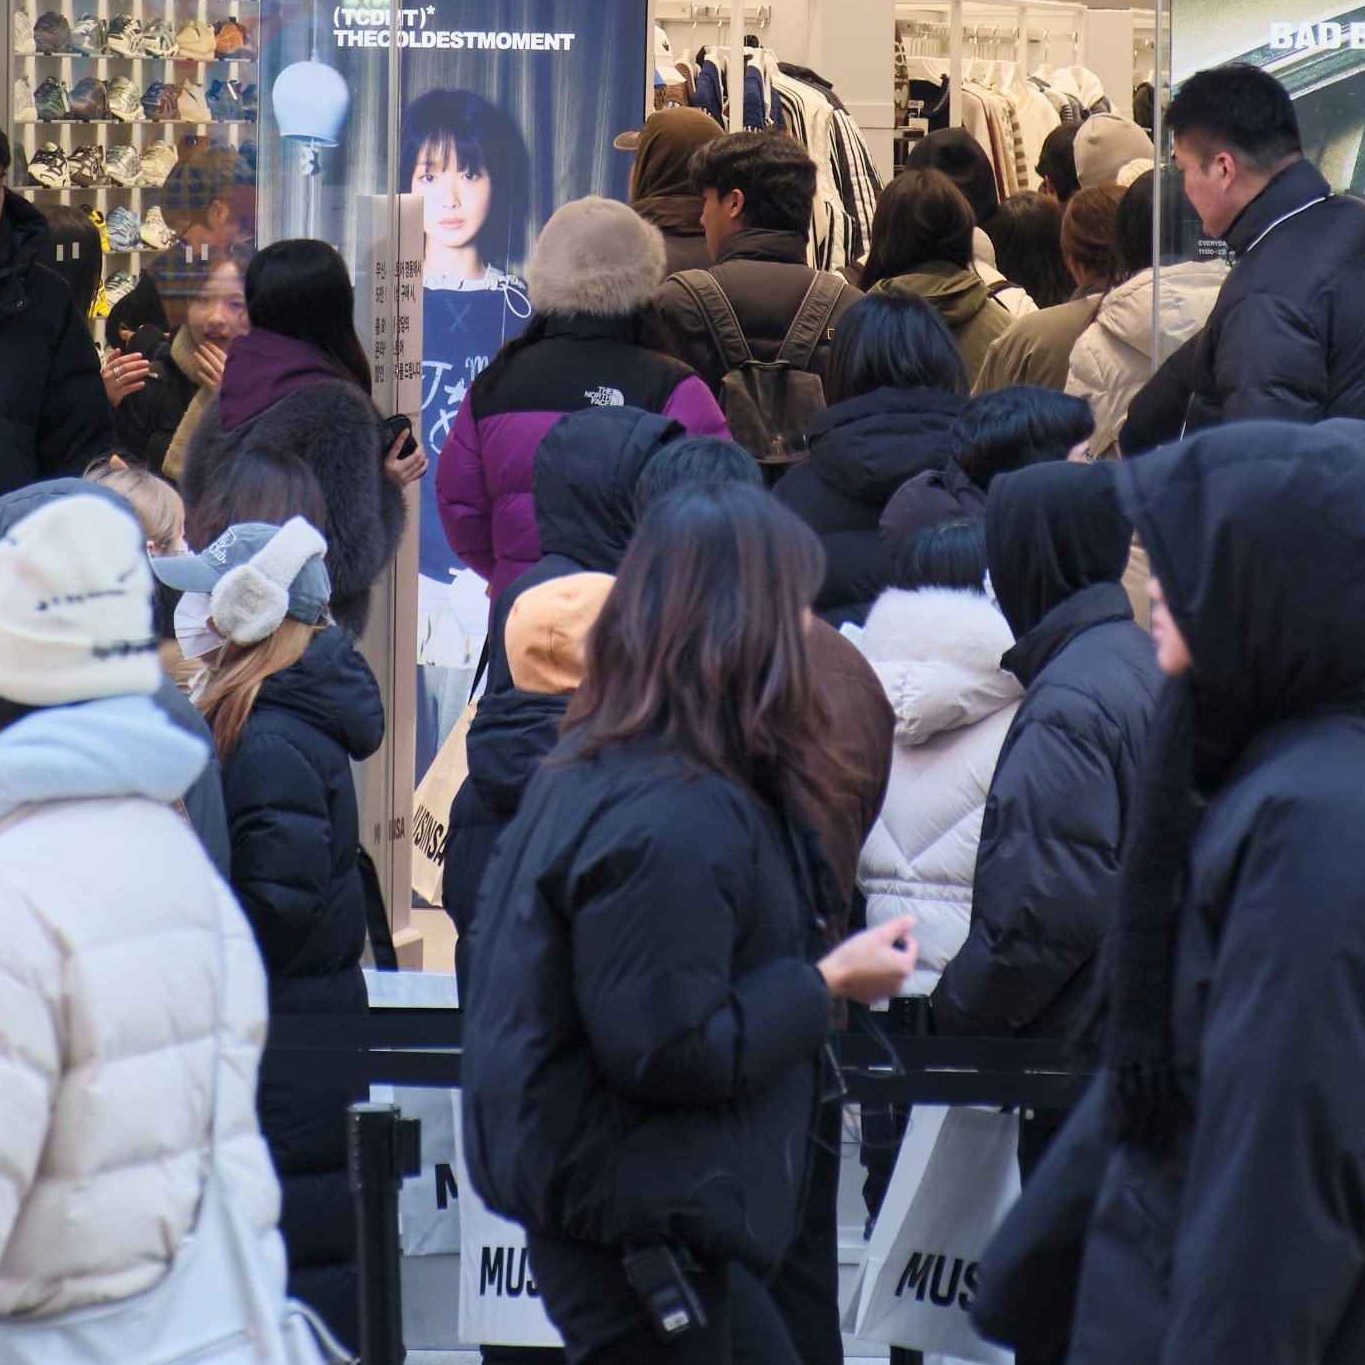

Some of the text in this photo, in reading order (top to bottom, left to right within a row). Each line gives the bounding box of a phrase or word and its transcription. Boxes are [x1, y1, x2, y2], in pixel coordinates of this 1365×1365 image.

[1269, 21, 1343, 50] BAD
[598, 386, 614, 394] THE
[584, 391, 612, 402] NORTH
[591, 398, 611, 406] FACE
[413, 804, 446, 867] USINSA
